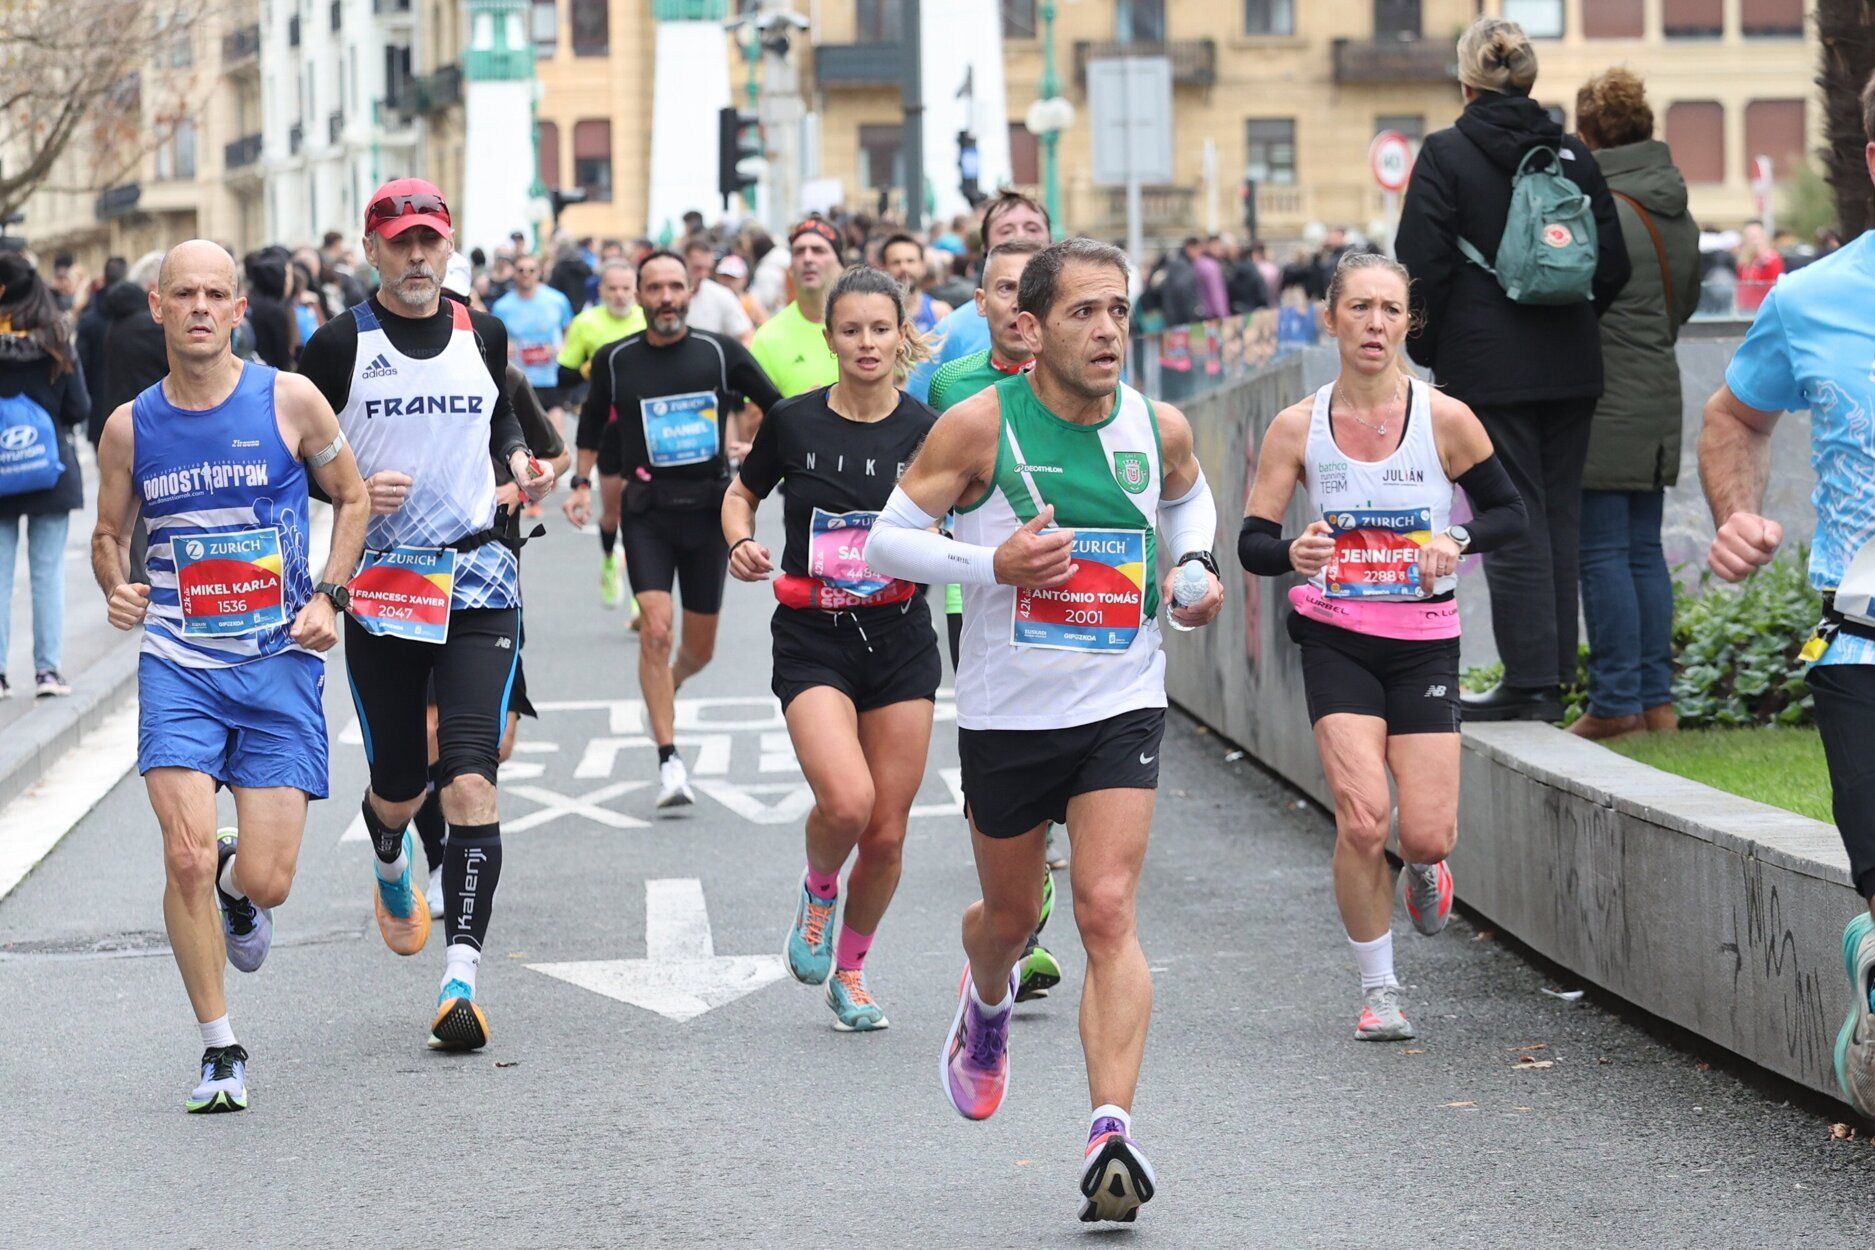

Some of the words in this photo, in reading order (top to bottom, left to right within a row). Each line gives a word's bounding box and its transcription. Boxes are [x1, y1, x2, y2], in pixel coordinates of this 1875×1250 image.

[362, 367, 397, 379] adidas
[365, 395, 483, 419] FRANCE
[662, 421, 709, 438] DANIEL
[806, 452, 905, 479] NIKE
[1024, 465, 1063, 473] DECATHLON
[1319, 462, 1348, 473] bathco
[1382, 468, 1424, 482] JULIÁN
[1320, 480, 1348, 494] TEAM
[1361, 516, 1415, 528] ZURICH
[210, 540, 260, 554] ZURICH
[1071, 540, 1126, 554] ZURICH
[387, 553, 437, 566] ZURICH
[1363, 570, 1397, 583] 2288
[190, 584, 231, 596] MIKEL
[232, 577, 278, 594] KARLA
[355, 590, 408, 603] FRANCESC
[409, 595, 446, 608] XAVIER
[1032, 589, 1095, 603] ANTÓNIO
[1097, 591, 1139, 604] TOMÁS
[217, 599, 247, 613] 1536
[378, 605, 414, 620] 2047
[1305, 595, 1350, 616] LURBEL
[1065, 609, 1103, 624] 2001
[457, 848, 487, 930] kalenji
